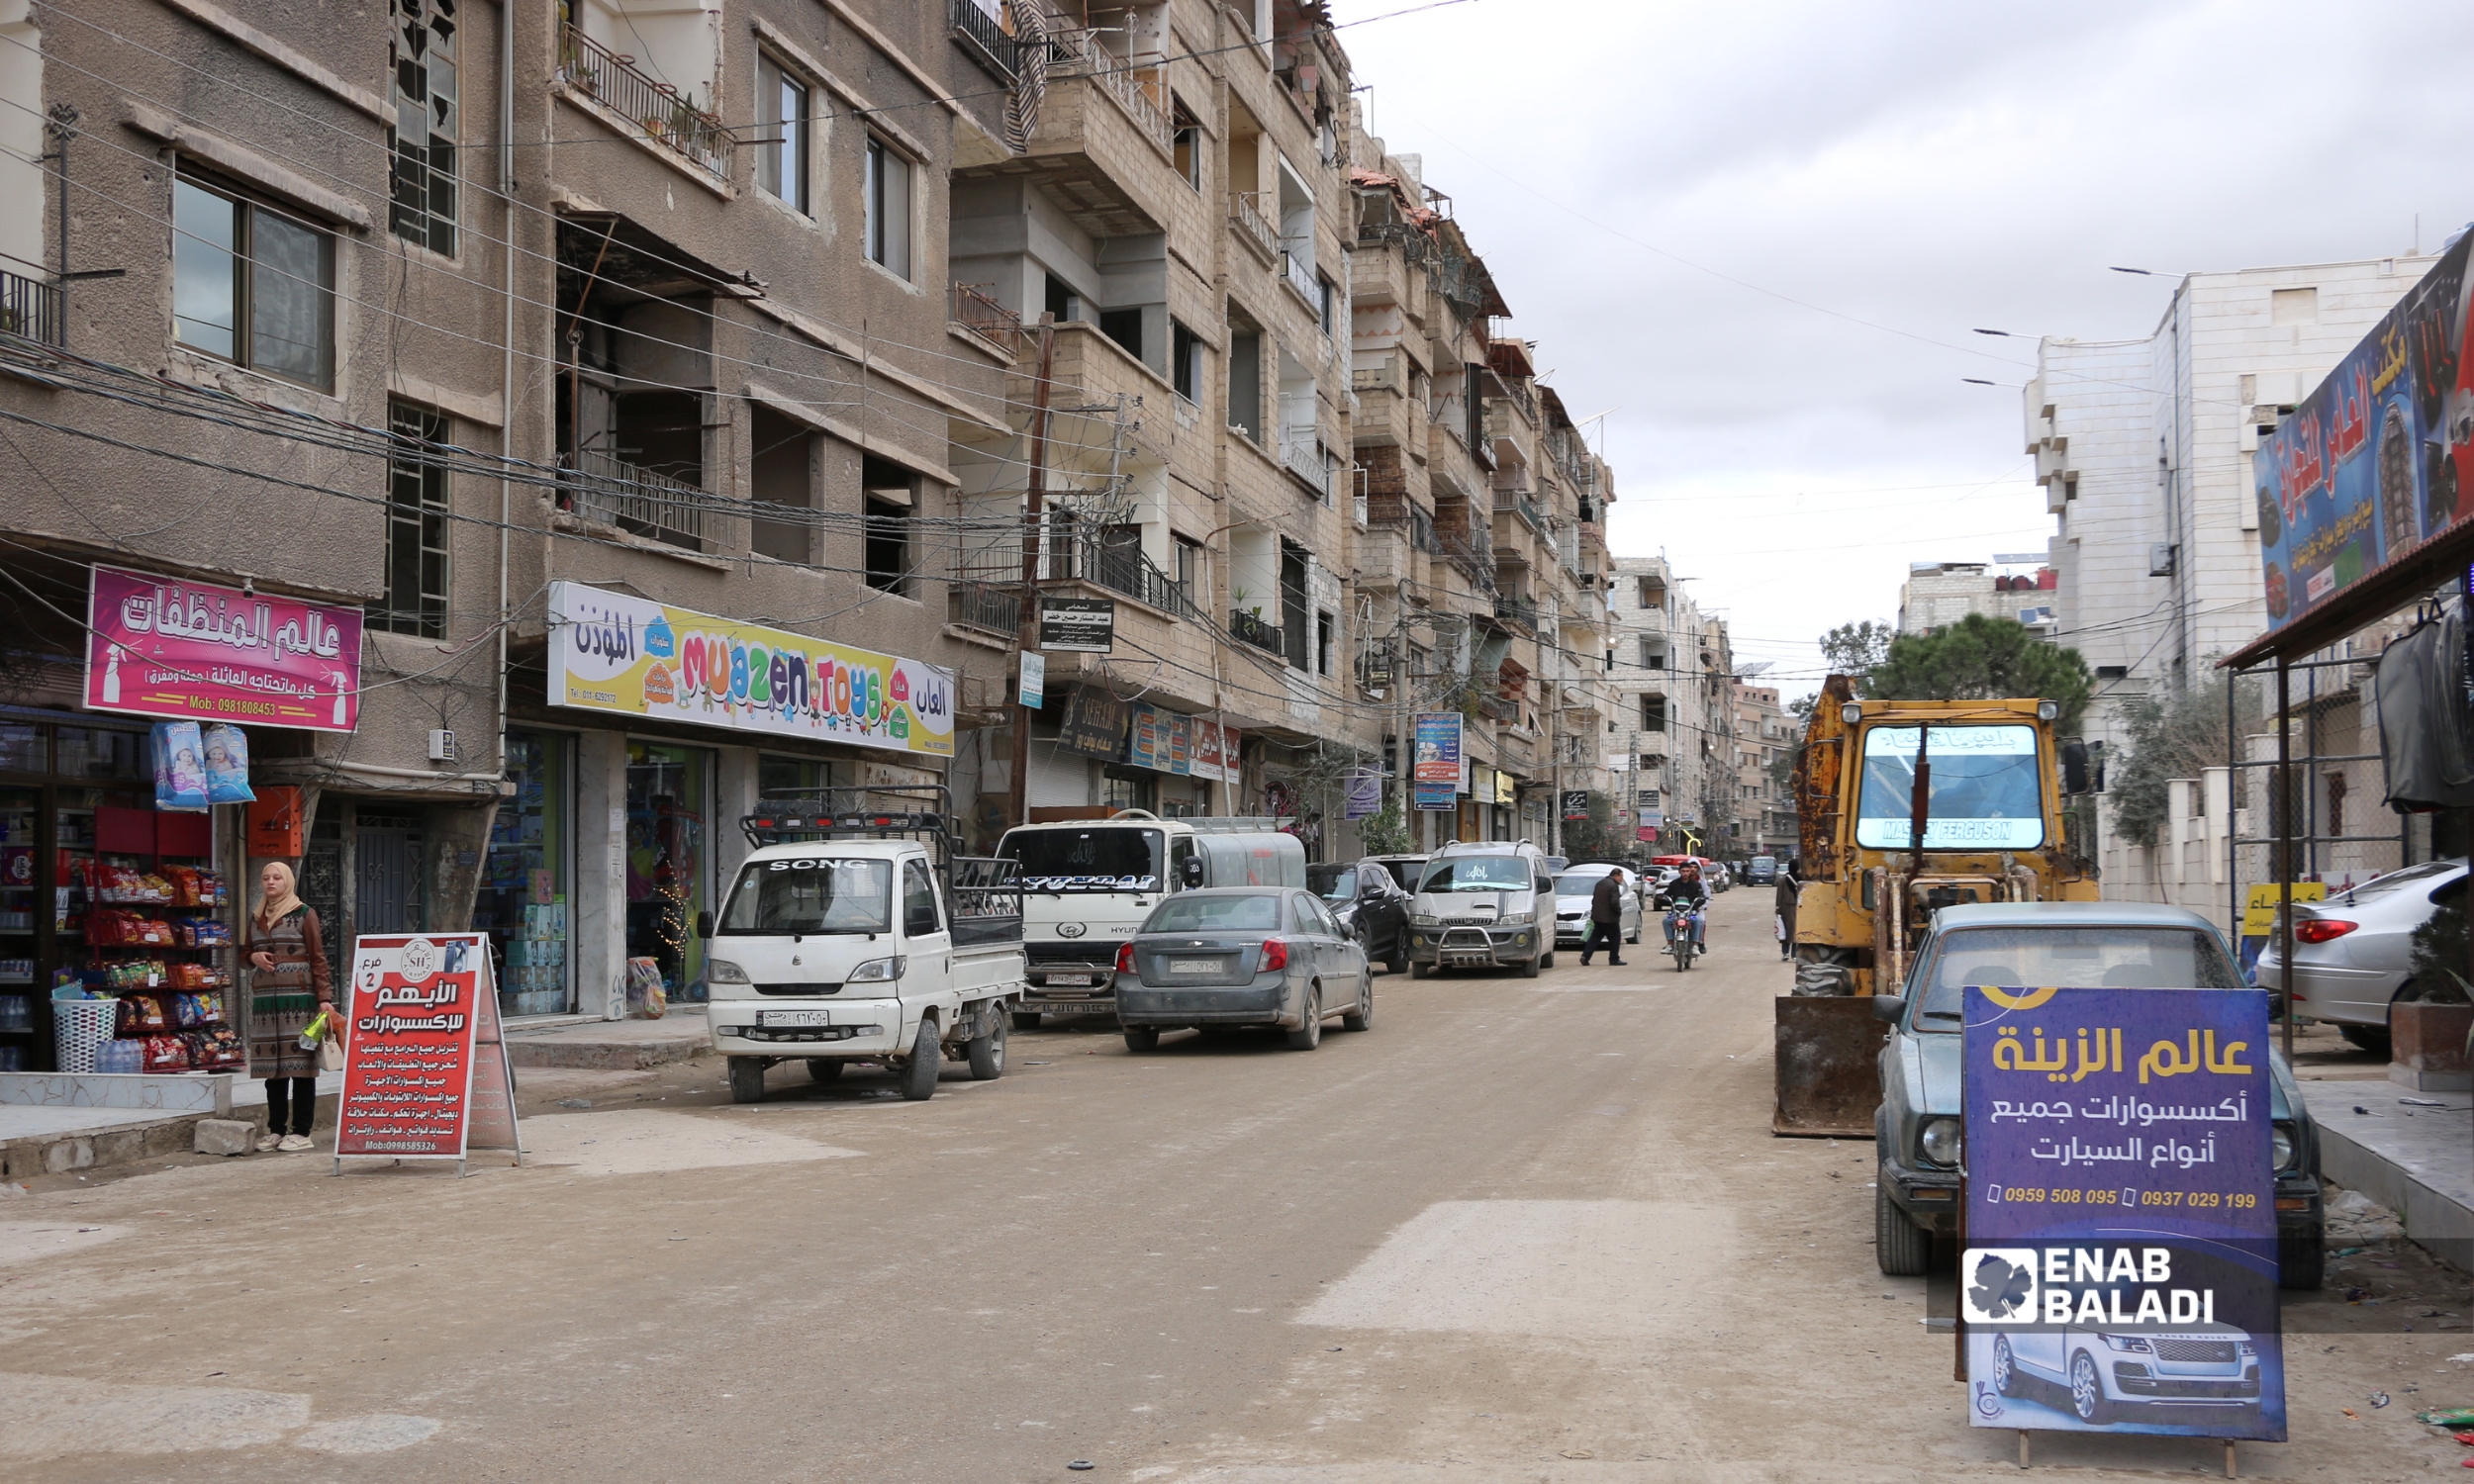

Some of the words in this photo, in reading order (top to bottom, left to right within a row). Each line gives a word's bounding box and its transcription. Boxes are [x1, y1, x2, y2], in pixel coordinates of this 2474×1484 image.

[2372, 323, 2408, 406] مكتب
[2324, 358, 2371, 501] العامر
[122, 585, 270, 650] المنظفات
[1062, 613, 1078, 622] حسين
[1079, 613, 1096, 622] الستار
[274, 610, 340, 663] عالم
[576, 603, 634, 667] المؤذن
[212, 666, 247, 686] العائلة
[297, 683, 316, 700] كل
[916, 678, 946, 720] ألعاب
[189, 696, 216, 710] Mob:
[218, 699, 276, 716] 0981808453
[1883, 821, 1939, 840] MASEY
[1940, 821, 2012, 840] FERGUSON
[769, 860, 869, 871] SONG
[362, 956, 382, 971] فرع
[409, 958, 427, 968] SH
[365, 973, 375, 987] 2
[374, 978, 458, 1010] الأيهم
[418, 1044, 435, 1056] جميع
[1992, 1026, 2123, 1083] الزينة
[2139, 1029, 2252, 1084] عالم
[422, 1060, 438, 1071] جميع
[424, 1076, 446, 1088] جميع
[392, 1107, 410, 1118] تحكم
[1990, 1100, 2073, 1124] جميع
[2081, 1090, 2248, 1127] أكسسوارات
[2031, 1136, 2142, 1166] السيارت
[2150, 1131, 2216, 1168] أنواع
[2005, 1187, 2046, 1203] 0959
[2050, 1187, 2080, 1203] 508
[2085, 1189, 2117, 1205] 095
[2141, 1191, 2183, 1206] 0937
[2187, 1192, 2219, 1207] 029
[2225, 1193, 2256, 1208] 199
